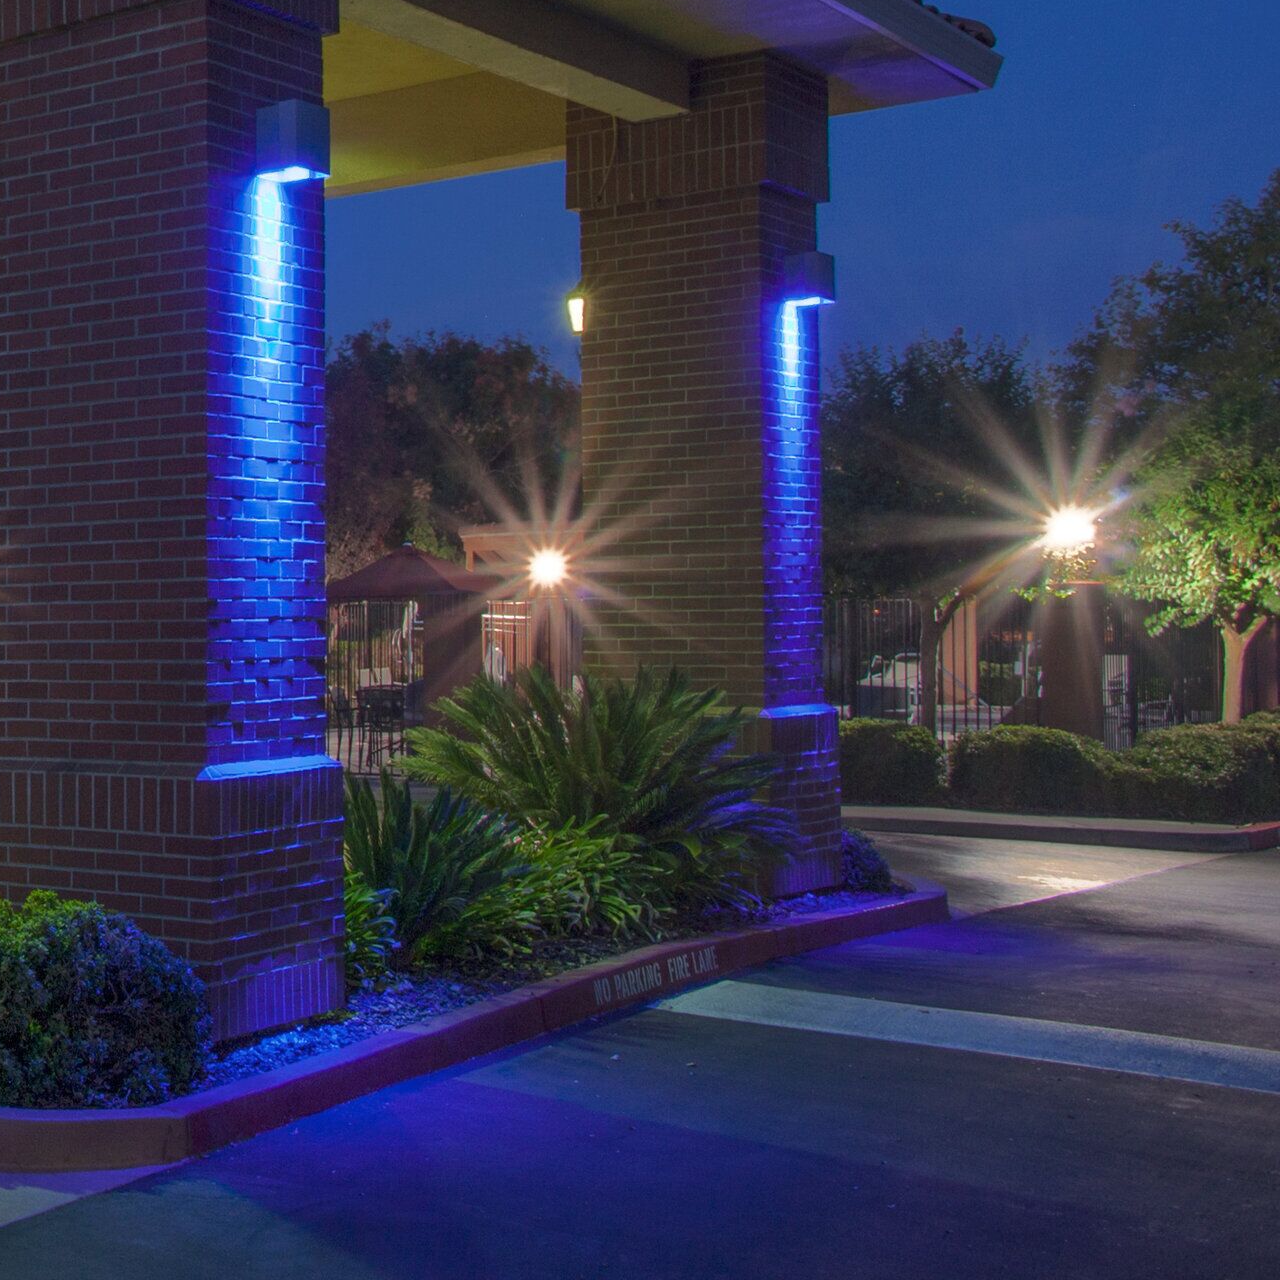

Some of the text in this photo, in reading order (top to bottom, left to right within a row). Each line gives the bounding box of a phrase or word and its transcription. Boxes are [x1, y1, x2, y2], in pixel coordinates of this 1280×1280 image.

[593, 946, 719, 1006] NO PARKING FIRE LANE
